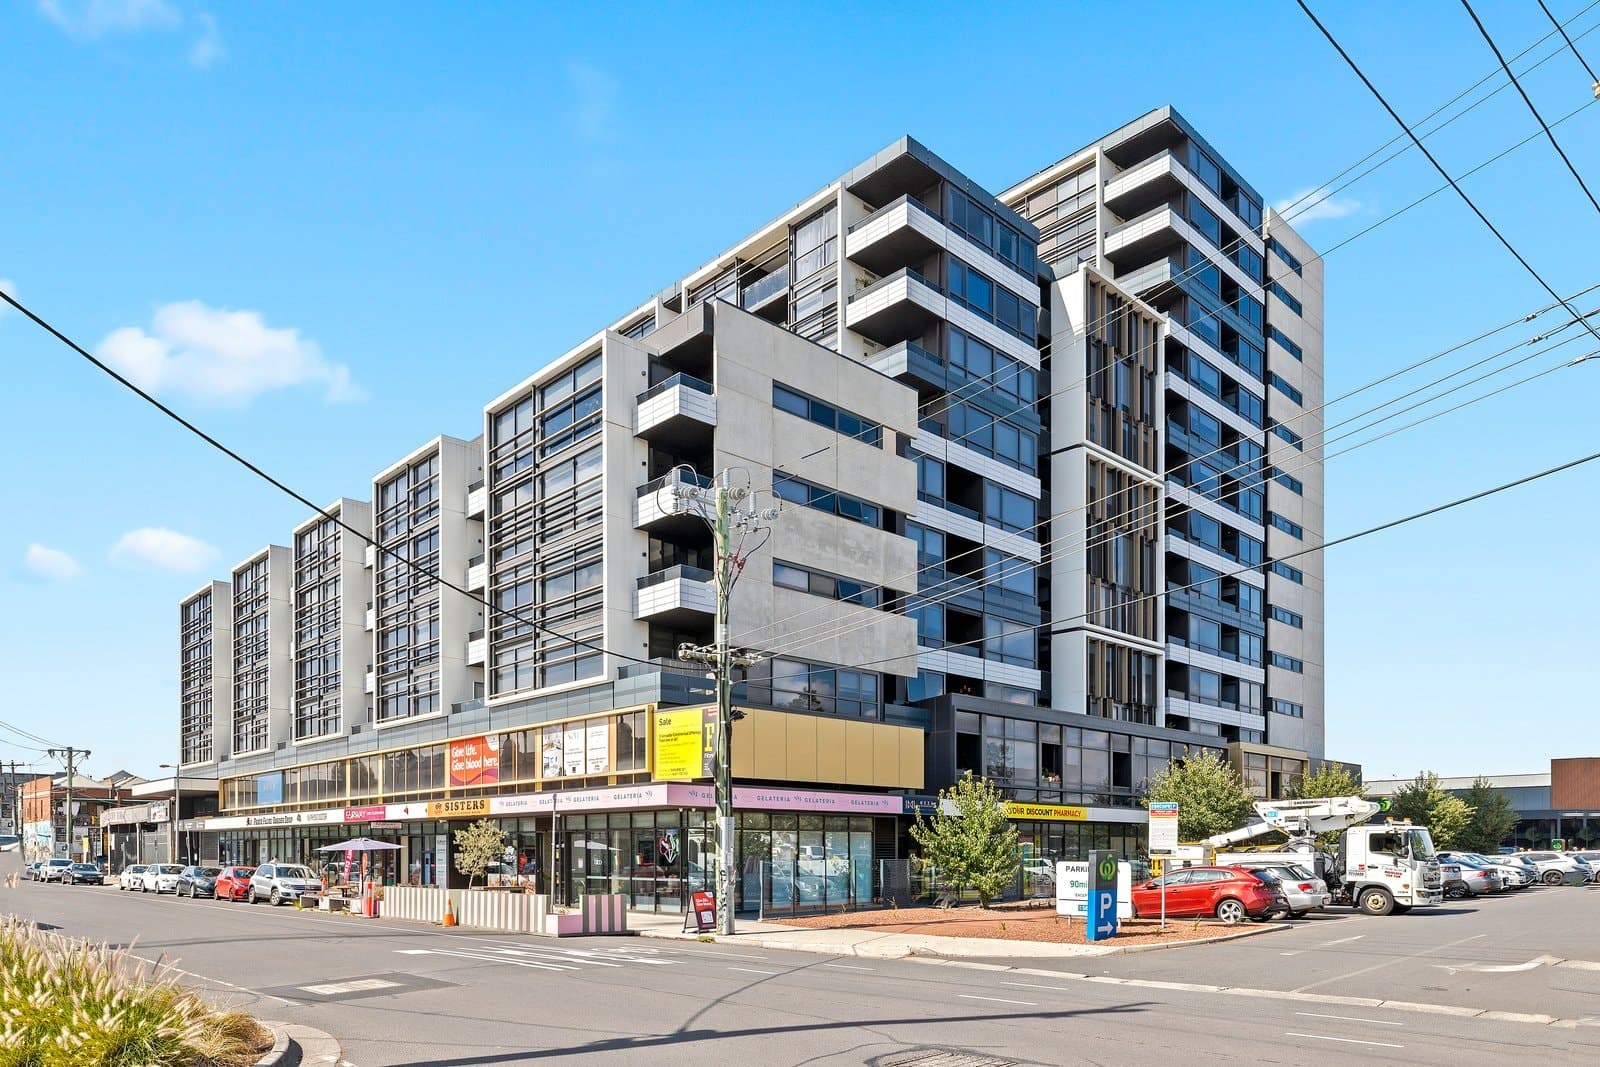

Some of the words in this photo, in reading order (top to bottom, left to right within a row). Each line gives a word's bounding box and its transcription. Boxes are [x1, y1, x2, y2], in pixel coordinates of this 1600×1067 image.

[659, 718, 672, 727] Sale
[704, 722, 715, 752] F
[452, 746, 465, 758] Give
[465, 744, 477, 756] life.
[452, 759, 465, 771] Give
[465, 756, 482, 769] blood
[445, 800, 485, 811] SISTERS
[1027, 808, 1052, 816] DISCOUNT
[1053, 809, 1081, 817] PHARMACY
[1069, 880, 1087, 888] 90mi
[1100, 892, 1112, 919] P
